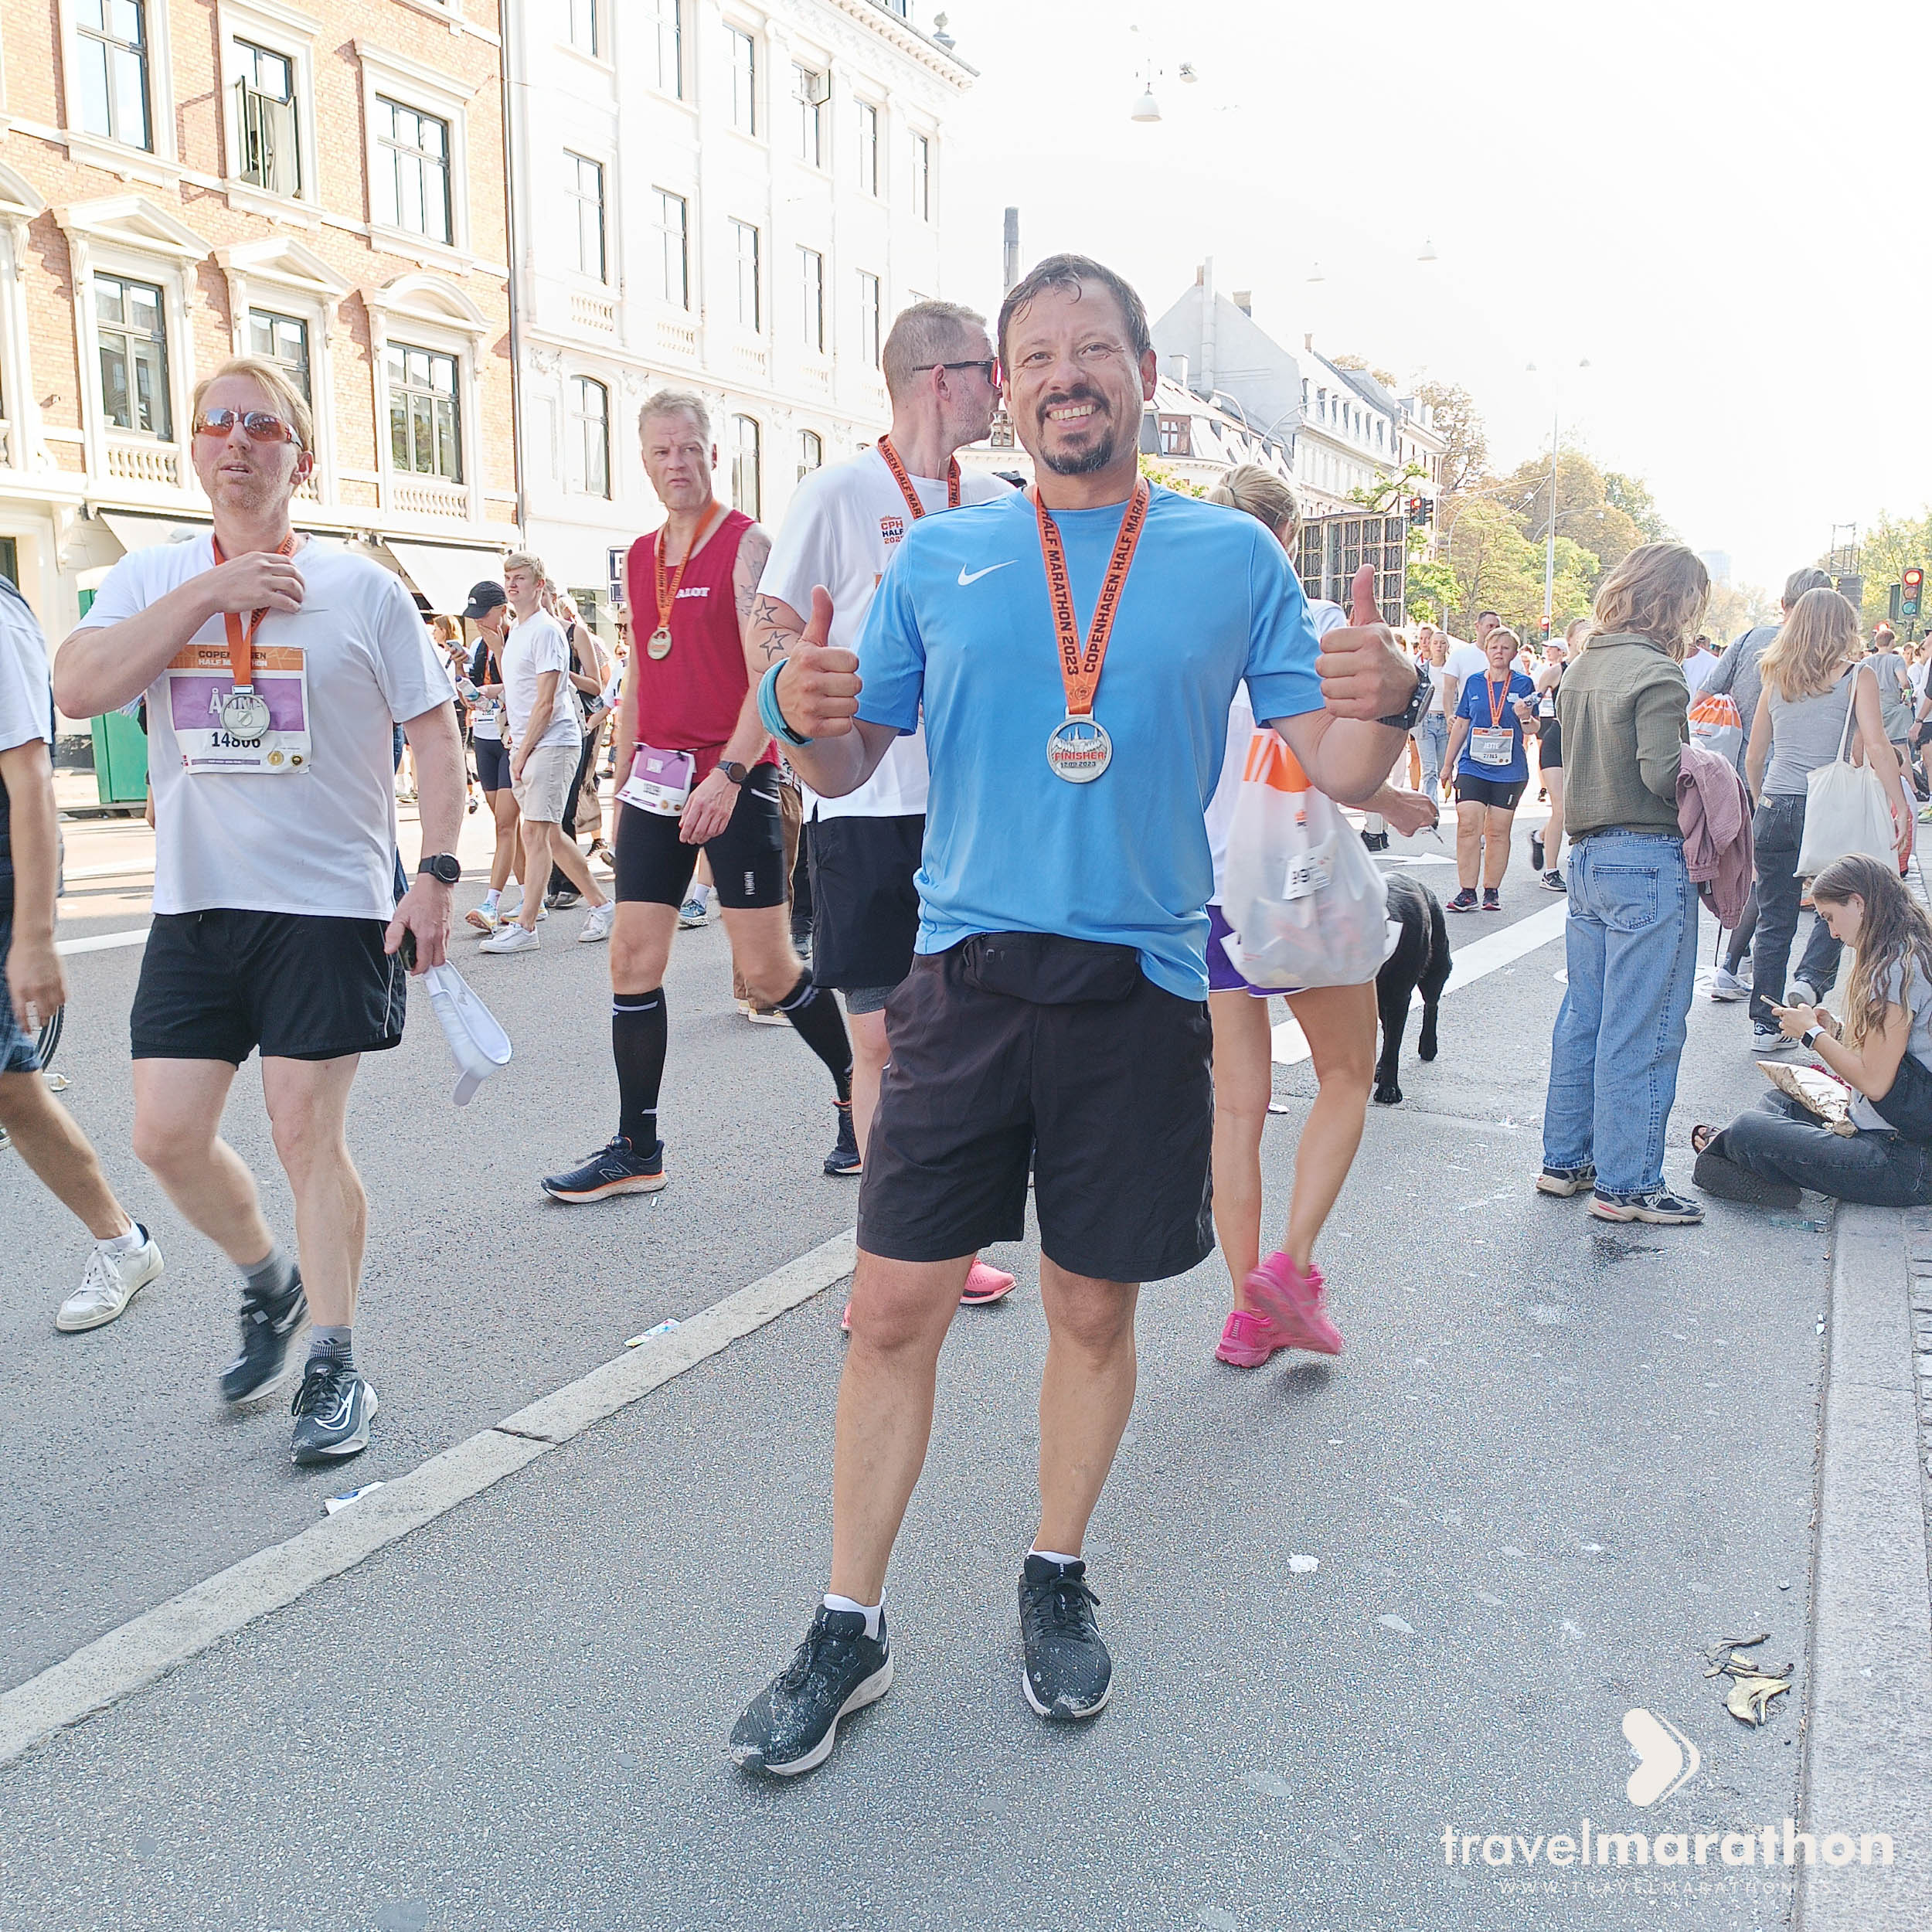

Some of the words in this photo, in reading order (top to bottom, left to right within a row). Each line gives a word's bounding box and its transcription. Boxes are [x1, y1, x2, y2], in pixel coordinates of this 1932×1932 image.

[894, 469, 911, 492] HALF
[906, 492, 923, 519] MAR
[880, 520, 903, 530] CPH
[1047, 549, 1073, 631] MARATHON
[1062, 636, 1080, 675] 2023
[1083, 573, 1121, 674] COPENHAGEN
[1112, 535, 1132, 571] HALF
[1054, 751, 1105, 761] FINISHER
